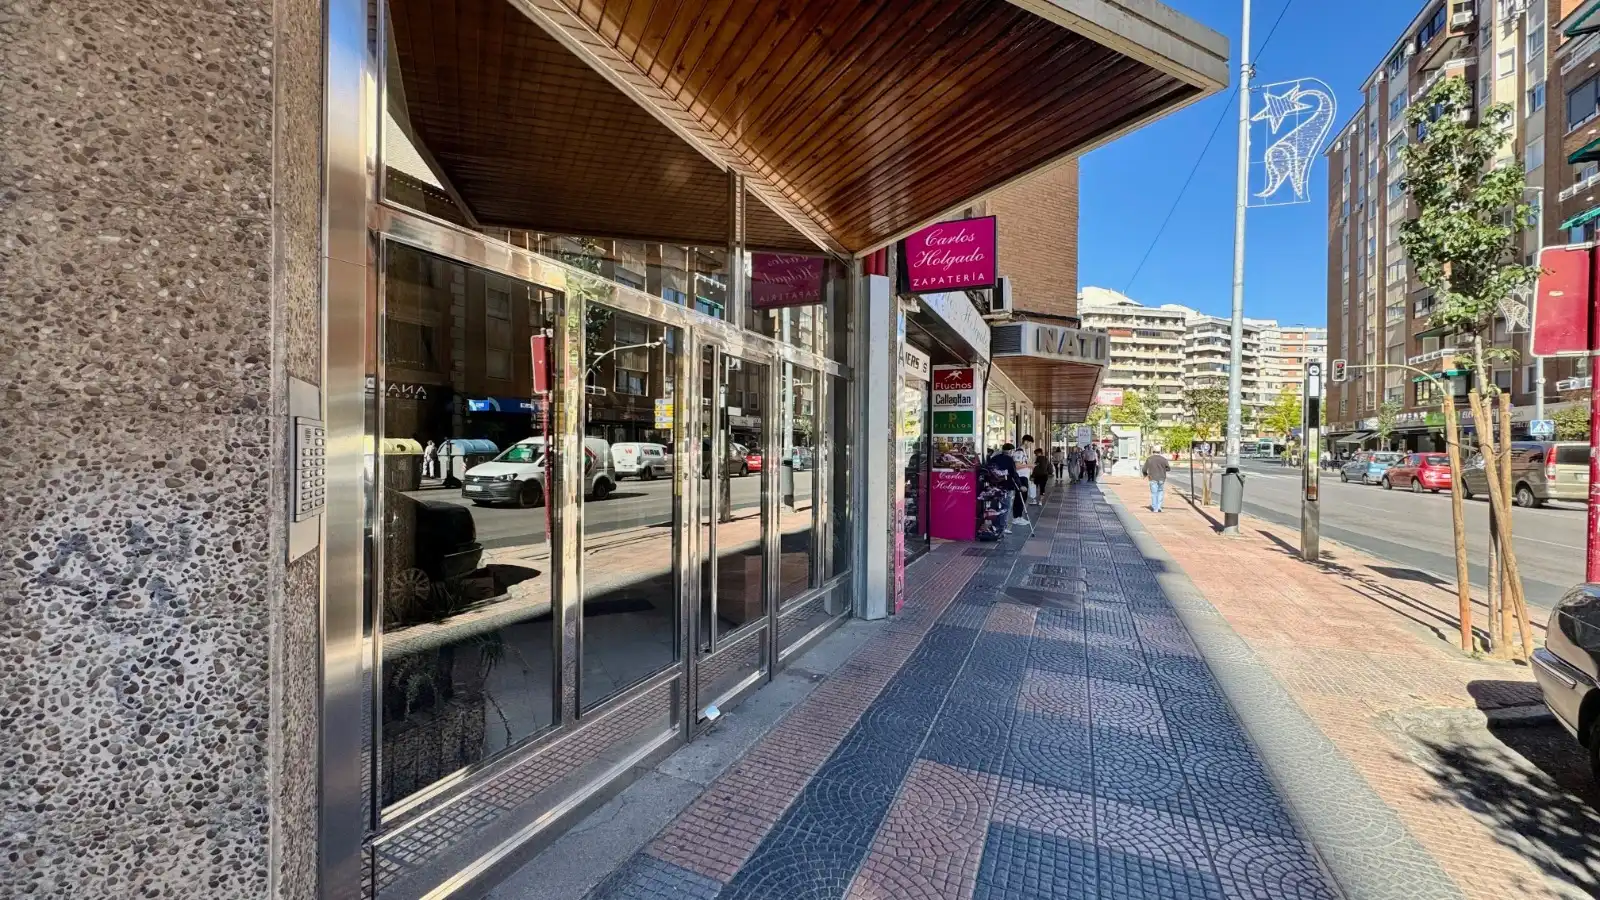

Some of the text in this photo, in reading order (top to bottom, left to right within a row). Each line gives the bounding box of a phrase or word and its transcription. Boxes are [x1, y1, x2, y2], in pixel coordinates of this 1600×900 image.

[925, 228, 975, 247] Carlos
[913, 247, 985, 271] Holgado
[913, 272, 985, 287] ZAPATERÍA
[935, 381, 972, 390] Fluchos
[939, 472, 966, 480] Carlos
[932, 480, 971, 491] Holgado
